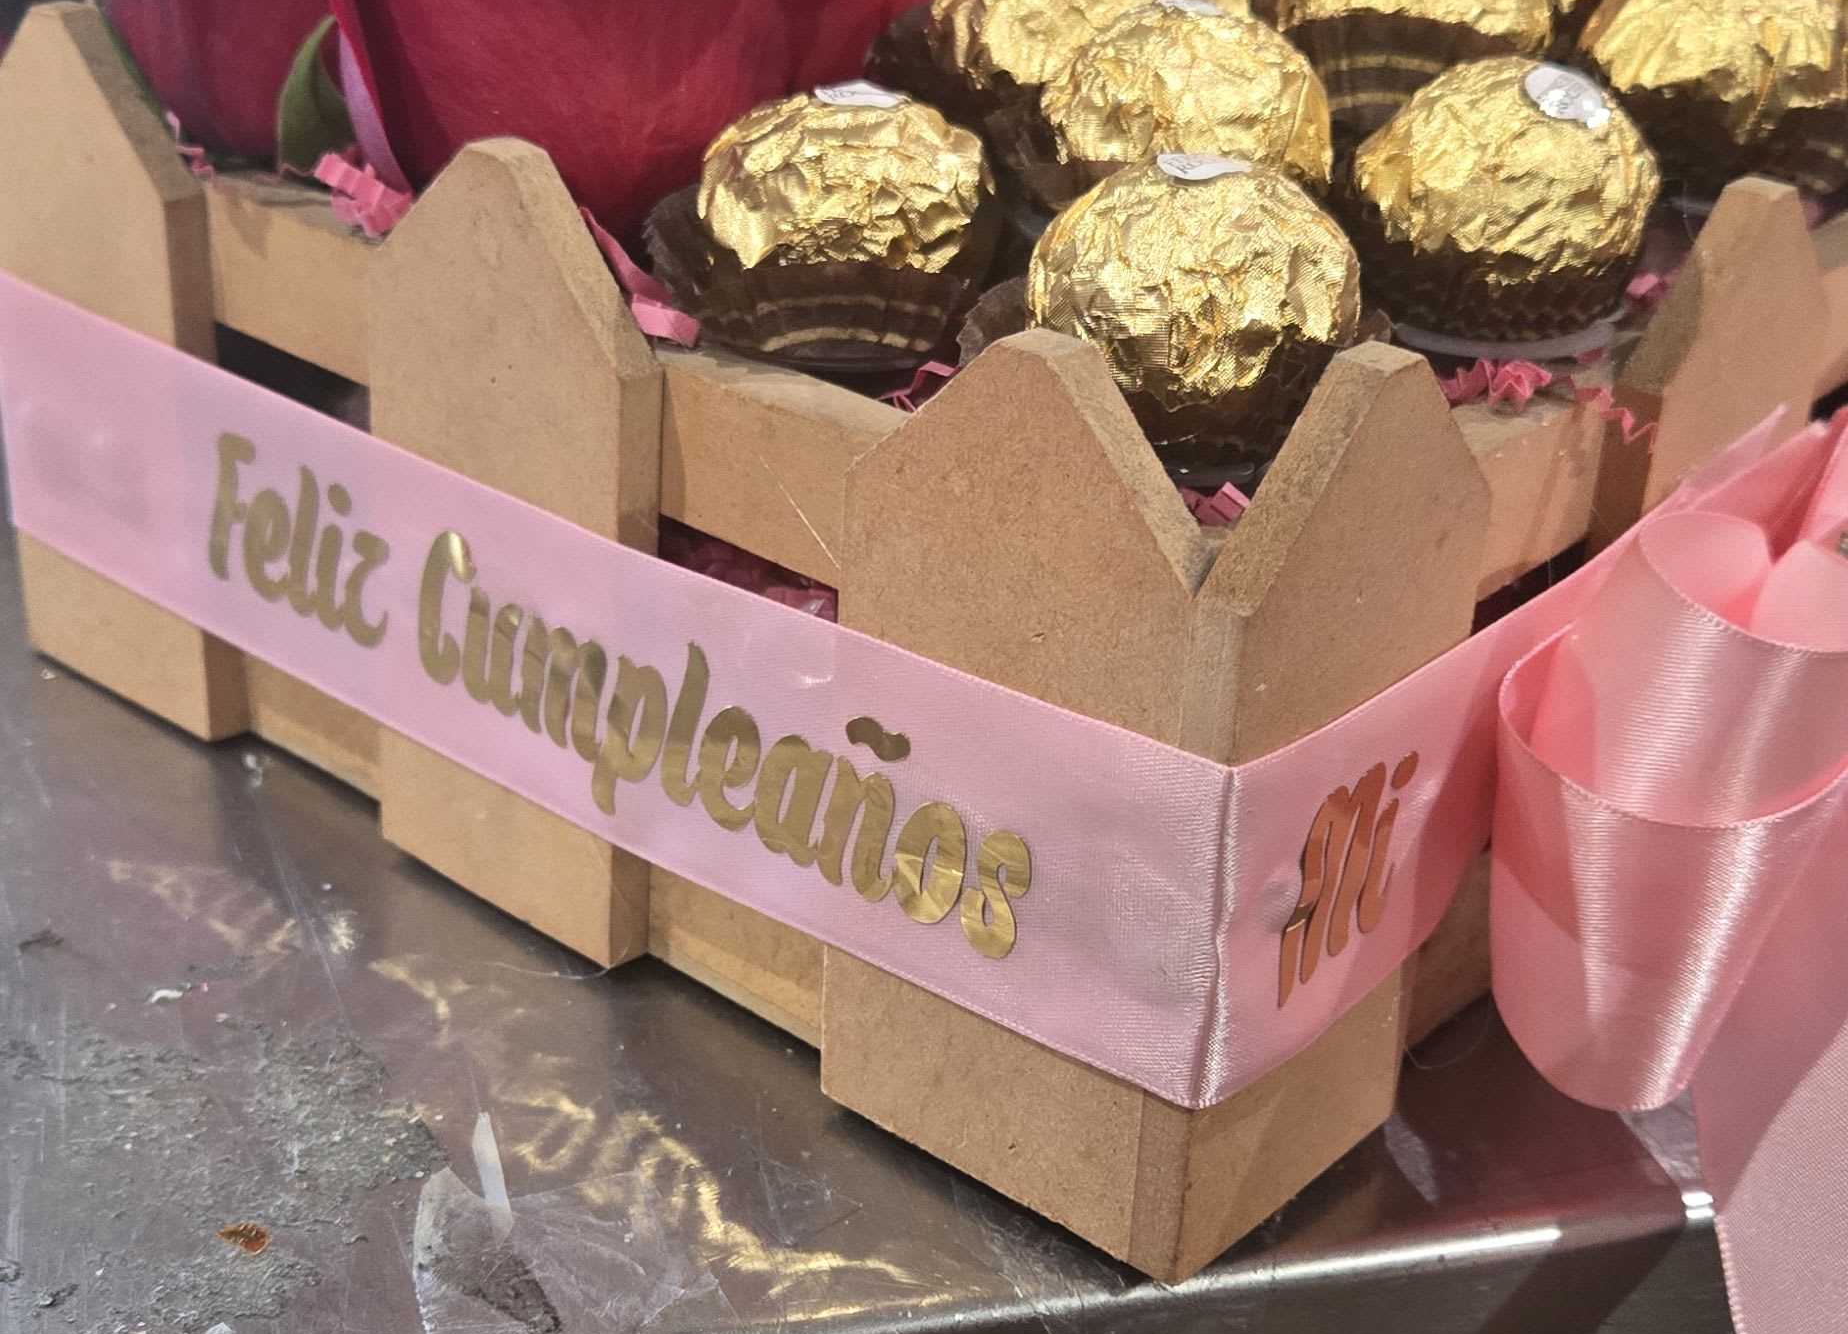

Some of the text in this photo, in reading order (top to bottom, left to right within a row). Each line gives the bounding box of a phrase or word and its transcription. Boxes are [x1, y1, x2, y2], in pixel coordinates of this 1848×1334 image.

[209, 431, 1031, 960] Feliz Cumpleaños
[1277, 751, 1419, 1011] Mi
